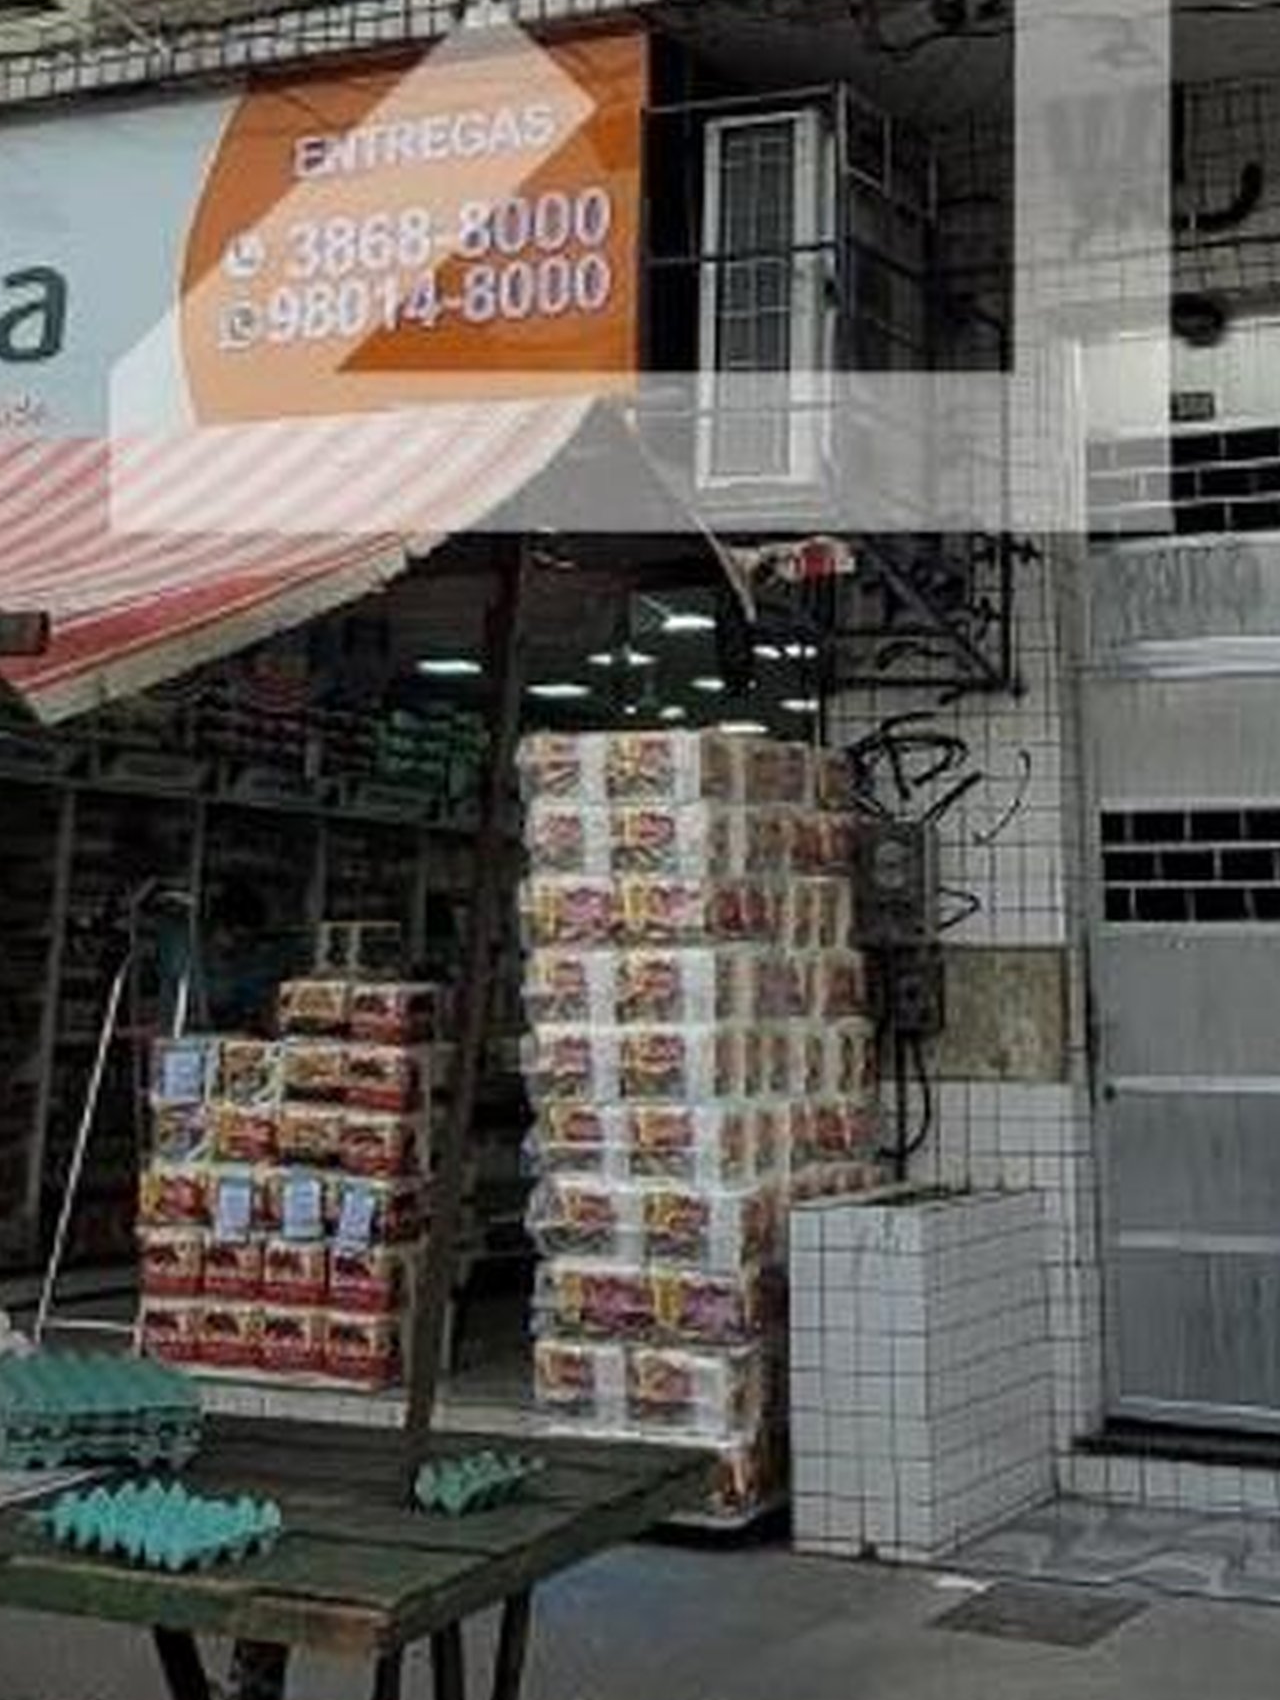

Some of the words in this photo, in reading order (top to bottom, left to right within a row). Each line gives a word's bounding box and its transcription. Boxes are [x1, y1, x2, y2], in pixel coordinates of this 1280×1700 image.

[294, 103, 556, 178] ENTREGAS
[288, 186, 613, 278] 3868-8000
[270, 254, 613, 342] 98014-8000
